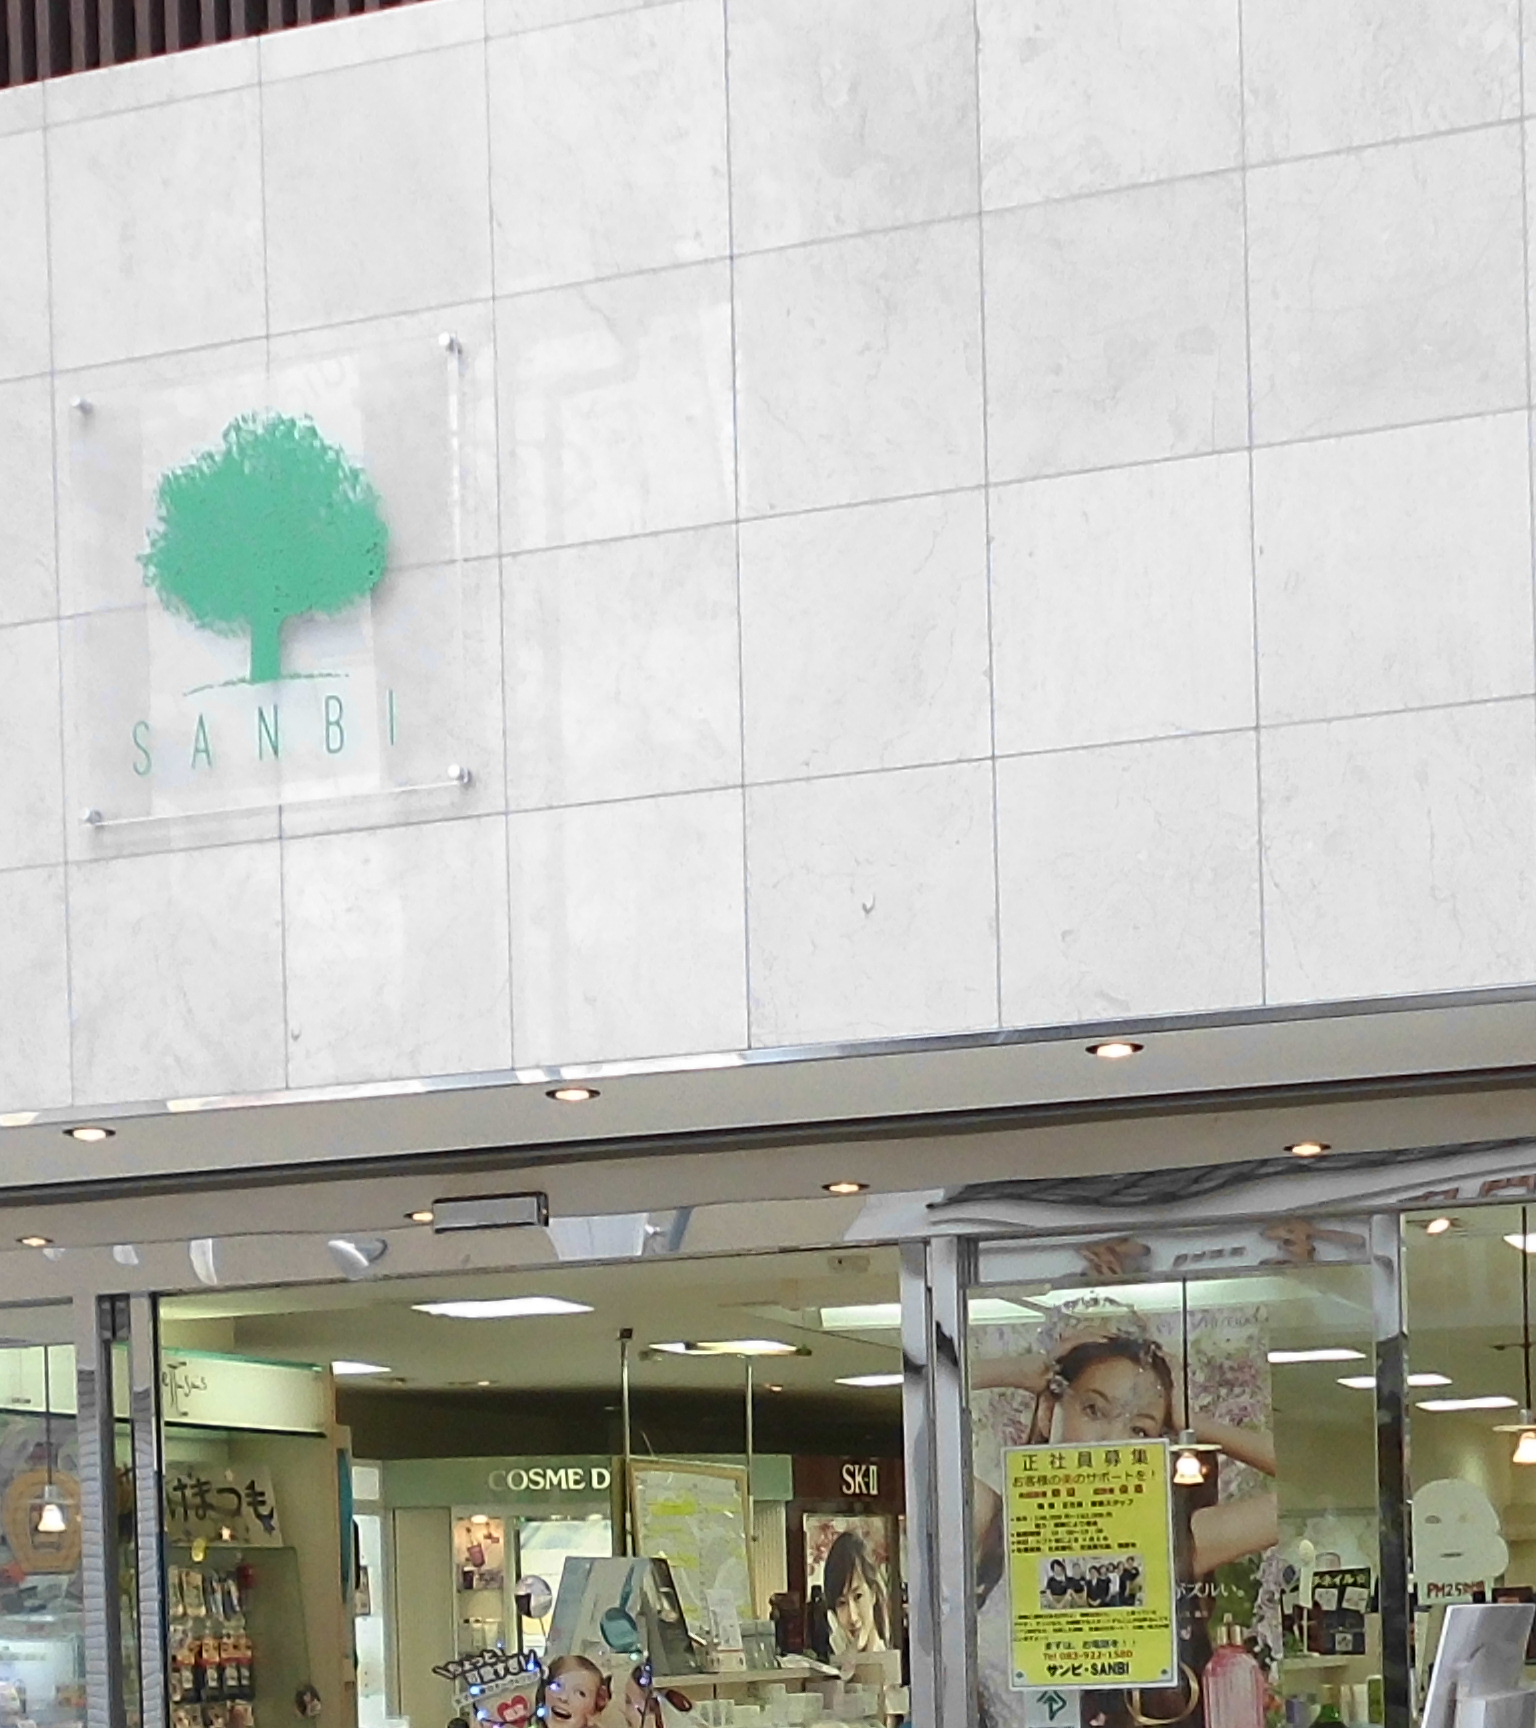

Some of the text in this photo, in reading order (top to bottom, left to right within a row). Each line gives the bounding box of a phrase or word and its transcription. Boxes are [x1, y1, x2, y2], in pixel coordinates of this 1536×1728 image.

[132, 689, 396, 776] SANBI
[1021, 1448, 1149, 1472] 正社員募集
[489, 1467, 611, 1492] COSME D
[841, 1464, 879, 1496] SK-II
